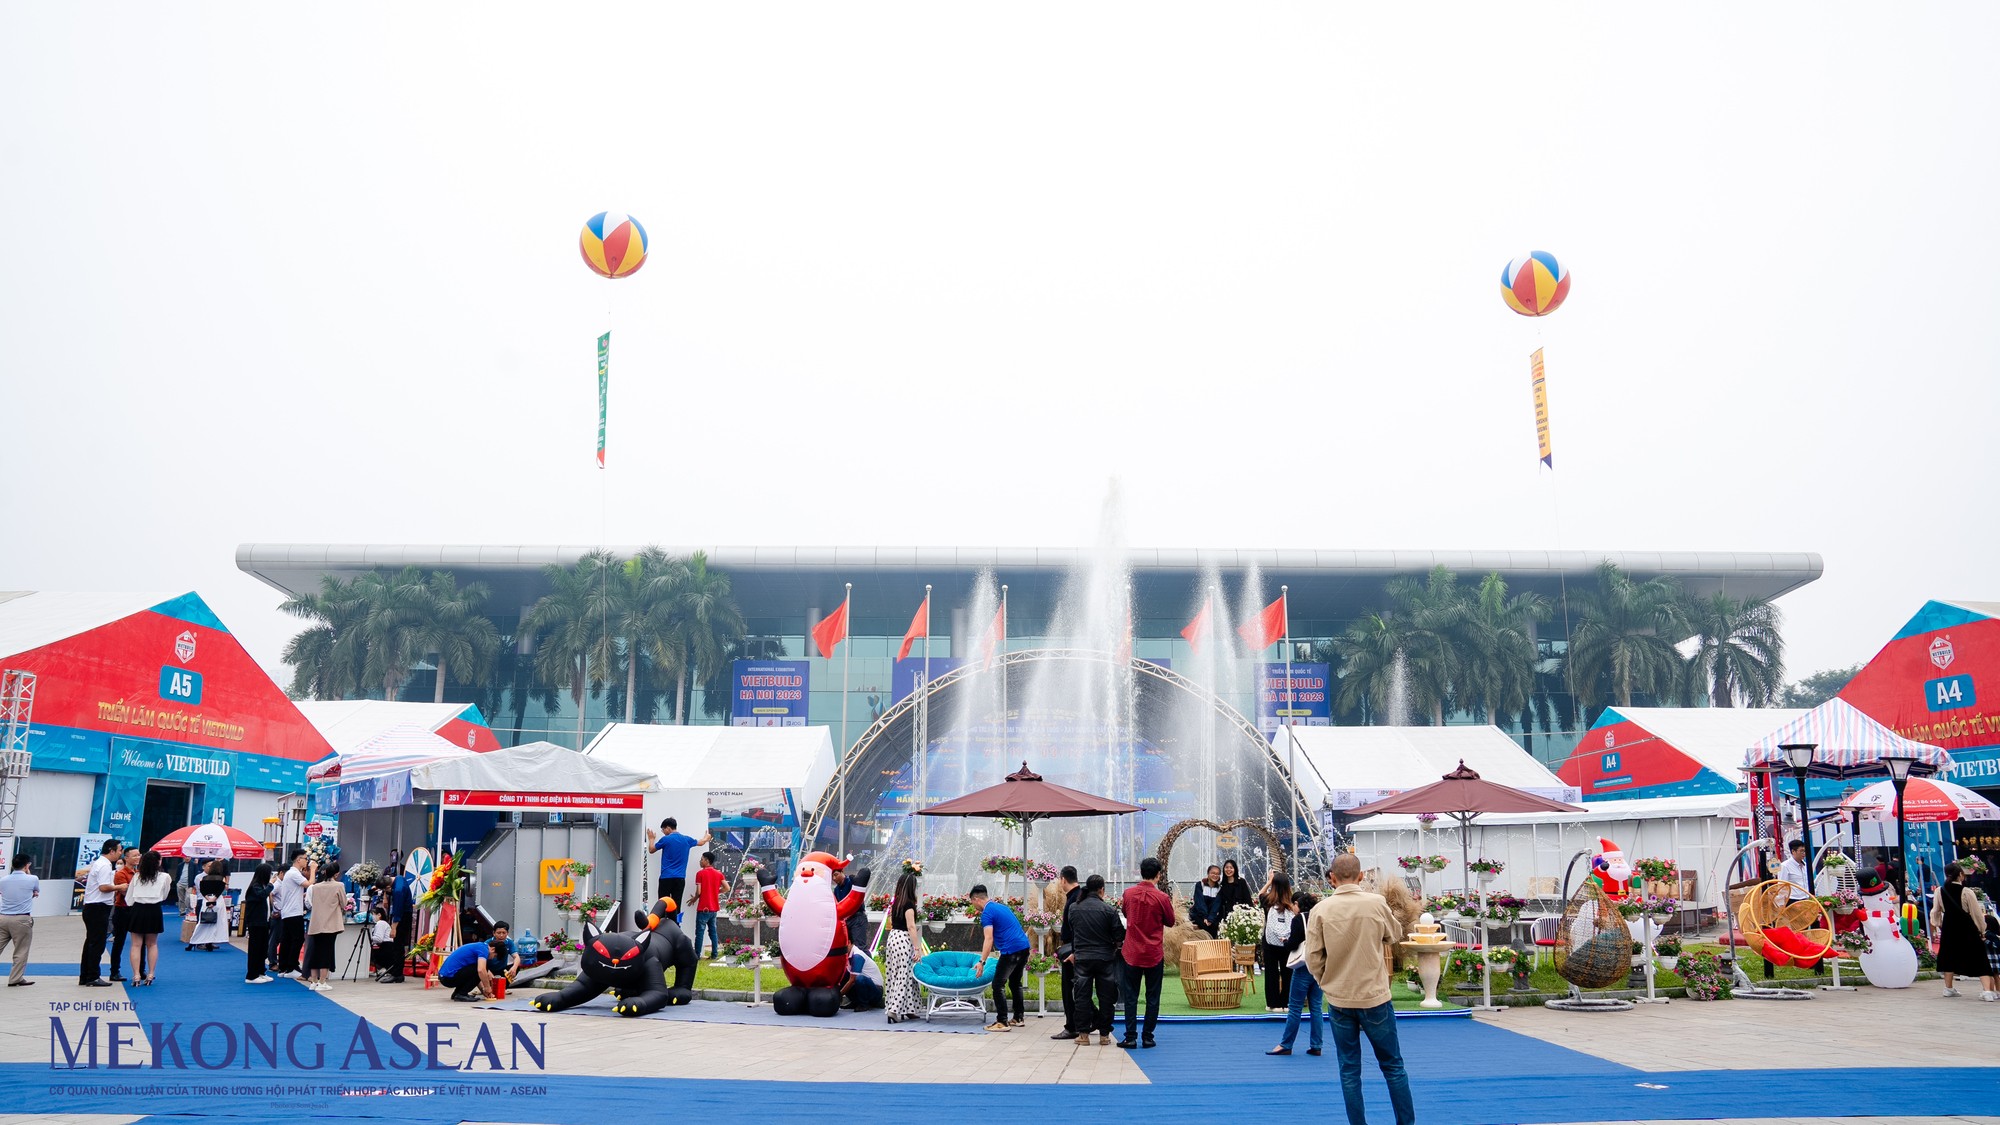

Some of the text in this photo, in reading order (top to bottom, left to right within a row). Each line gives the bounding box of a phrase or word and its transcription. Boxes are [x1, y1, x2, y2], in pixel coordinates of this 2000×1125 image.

[169, 672, 192, 697] A5
[741, 675, 802, 687] VIETBUILD
[740, 690, 802, 700] HA NOI 2023
[1299, 692, 1324, 702] 2023
[1937, 679, 1963, 705] A4
[98, 698, 245, 741] TRIỂN LÃM QUỐC TẾ VIETBUILD
[1933, 715, 1970, 740] QUỐC
[1969, 712, 1986, 735] TẾ
[121, 749, 230, 776] Welcome to VIETBUILD
[1606, 754, 1617, 769] A4
[1951, 758, 2000, 779] VIETB
[499, 794, 515, 802] CÔNG
[563, 795, 571, 804] VÀ
[110, 811, 131, 822] LIÊN HỆ
[212, 808, 225, 826] A5
